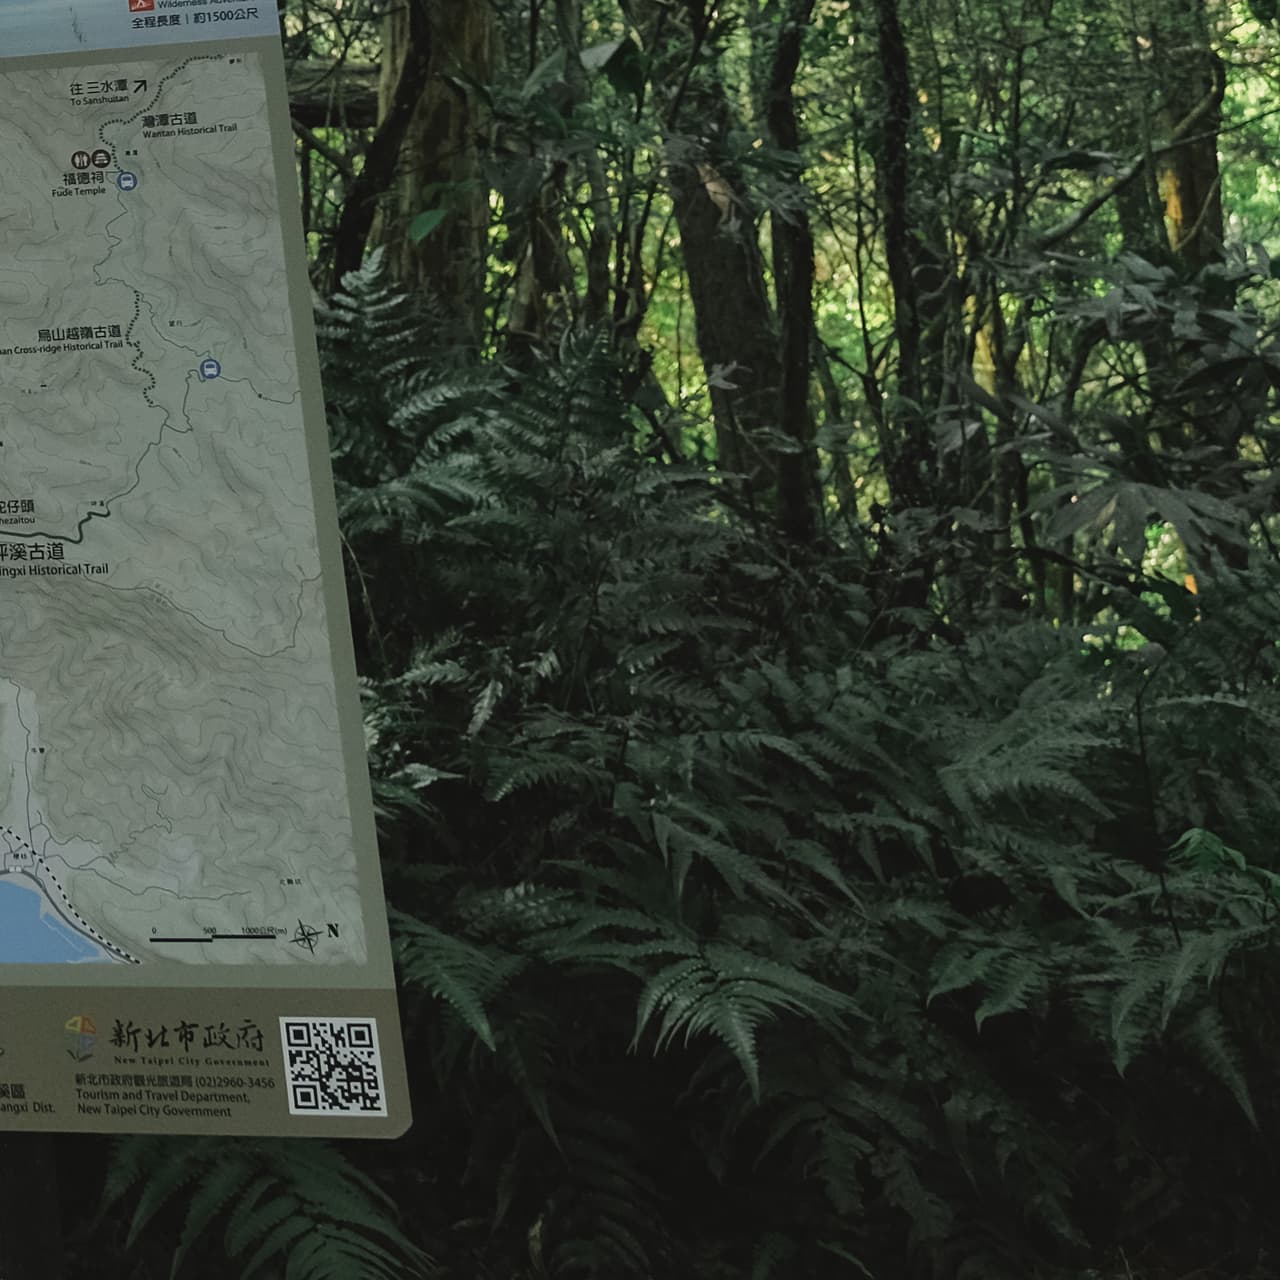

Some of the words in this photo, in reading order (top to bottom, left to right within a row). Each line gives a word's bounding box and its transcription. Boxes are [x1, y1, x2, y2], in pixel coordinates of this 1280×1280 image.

[71, 97, 82, 107] To
[177, 125, 217, 136] Historical
[218, 123, 238, 133] Trail
[63, 170, 105, 187] 福德祠
[52, 188, 74, 198] Fude
[75, 186, 107, 197] Temple
[14, 343, 62, 357] Cross-ridge
[63, 341, 104, 353] Historical
[104, 340, 124, 352] Trail
[28, 564, 83, 577] Historical
[85, 563, 109, 575] Trail
[326, 922, 339, 938] N
[109, 1018, 264, 1053] 新北市政府
[114, 1055, 135, 1065] New
[141, 1056, 174, 1068] Taipei
[178, 1056, 200, 1068] City
[205, 1056, 270, 1067] Government
[194, 1076, 276, 1090] (02)2960-3456
[75, 1088, 120, 1100] Tourism
[125, 1089, 142, 1101] and
[144, 1090, 179, 1101] Travel
[181, 1090, 251, 1104] Department,
[32, 1102, 56, 1114] Dist.
[78, 1103, 101, 1115] New
[104, 1103, 137, 1117] Taipei
[139, 1104, 160, 1117] City
[162, 1104, 232, 1117] Government
